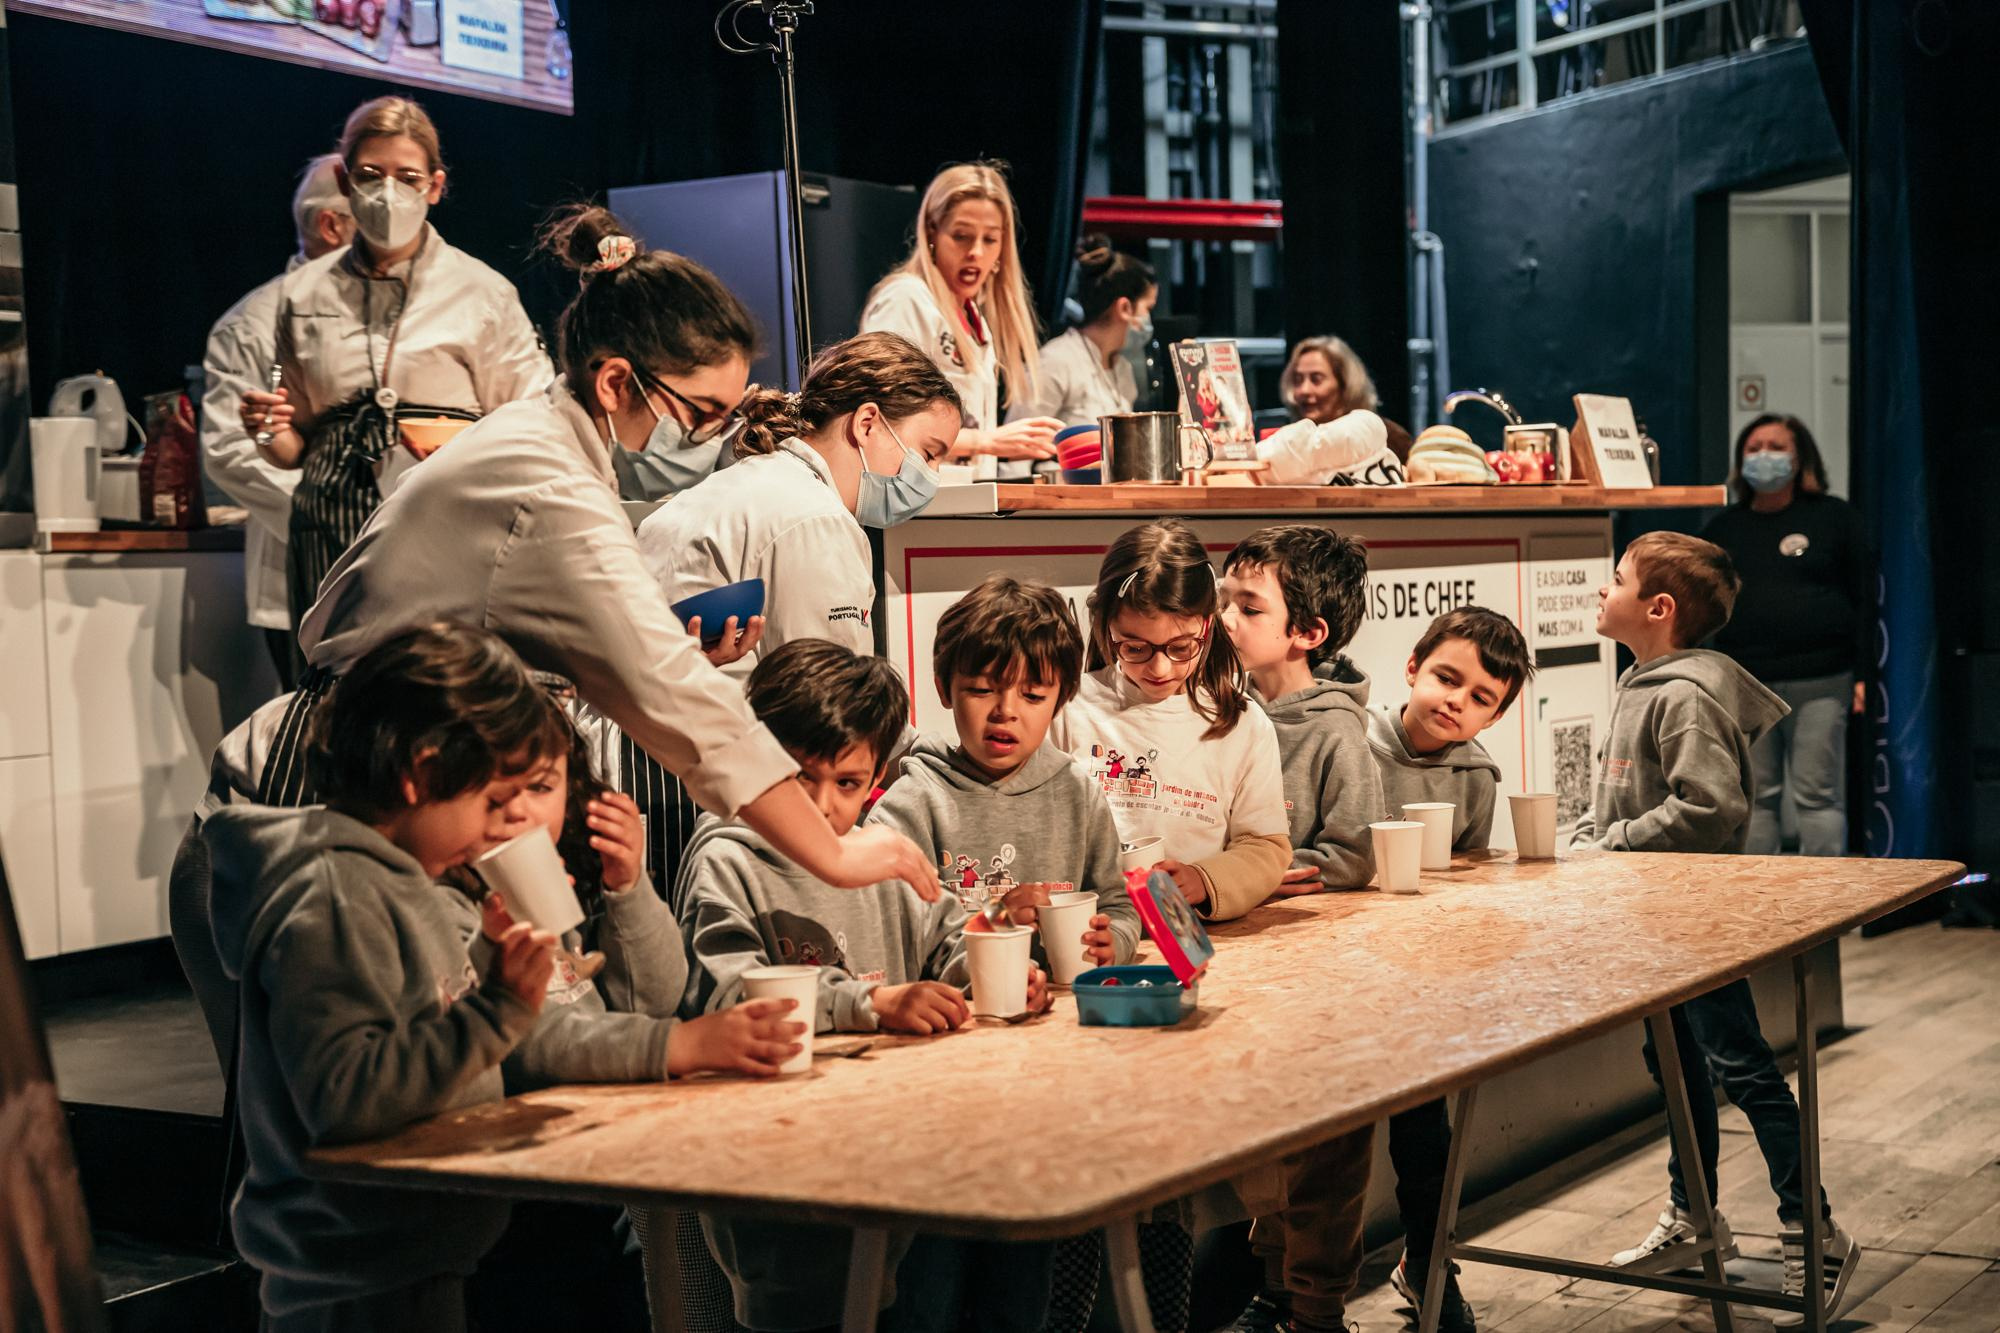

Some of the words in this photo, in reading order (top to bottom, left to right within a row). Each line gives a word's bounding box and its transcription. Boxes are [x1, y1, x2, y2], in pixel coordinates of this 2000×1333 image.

[1597, 427, 1630, 439] MAFALDA
[1604, 448, 1636, 460] TEIXEIRA
[1566, 569, 1586, 586] CASA
[1393, 582, 1419, 618] DE
[1537, 595, 1558, 612] PODE
[1559, 594, 1574, 611] SER
[828, 612, 860, 621] PORTUGAL
[1538, 620, 1558, 637] MAIS
[1559, 619, 1577, 636] COM
[1184, 788, 1193, 797] de
